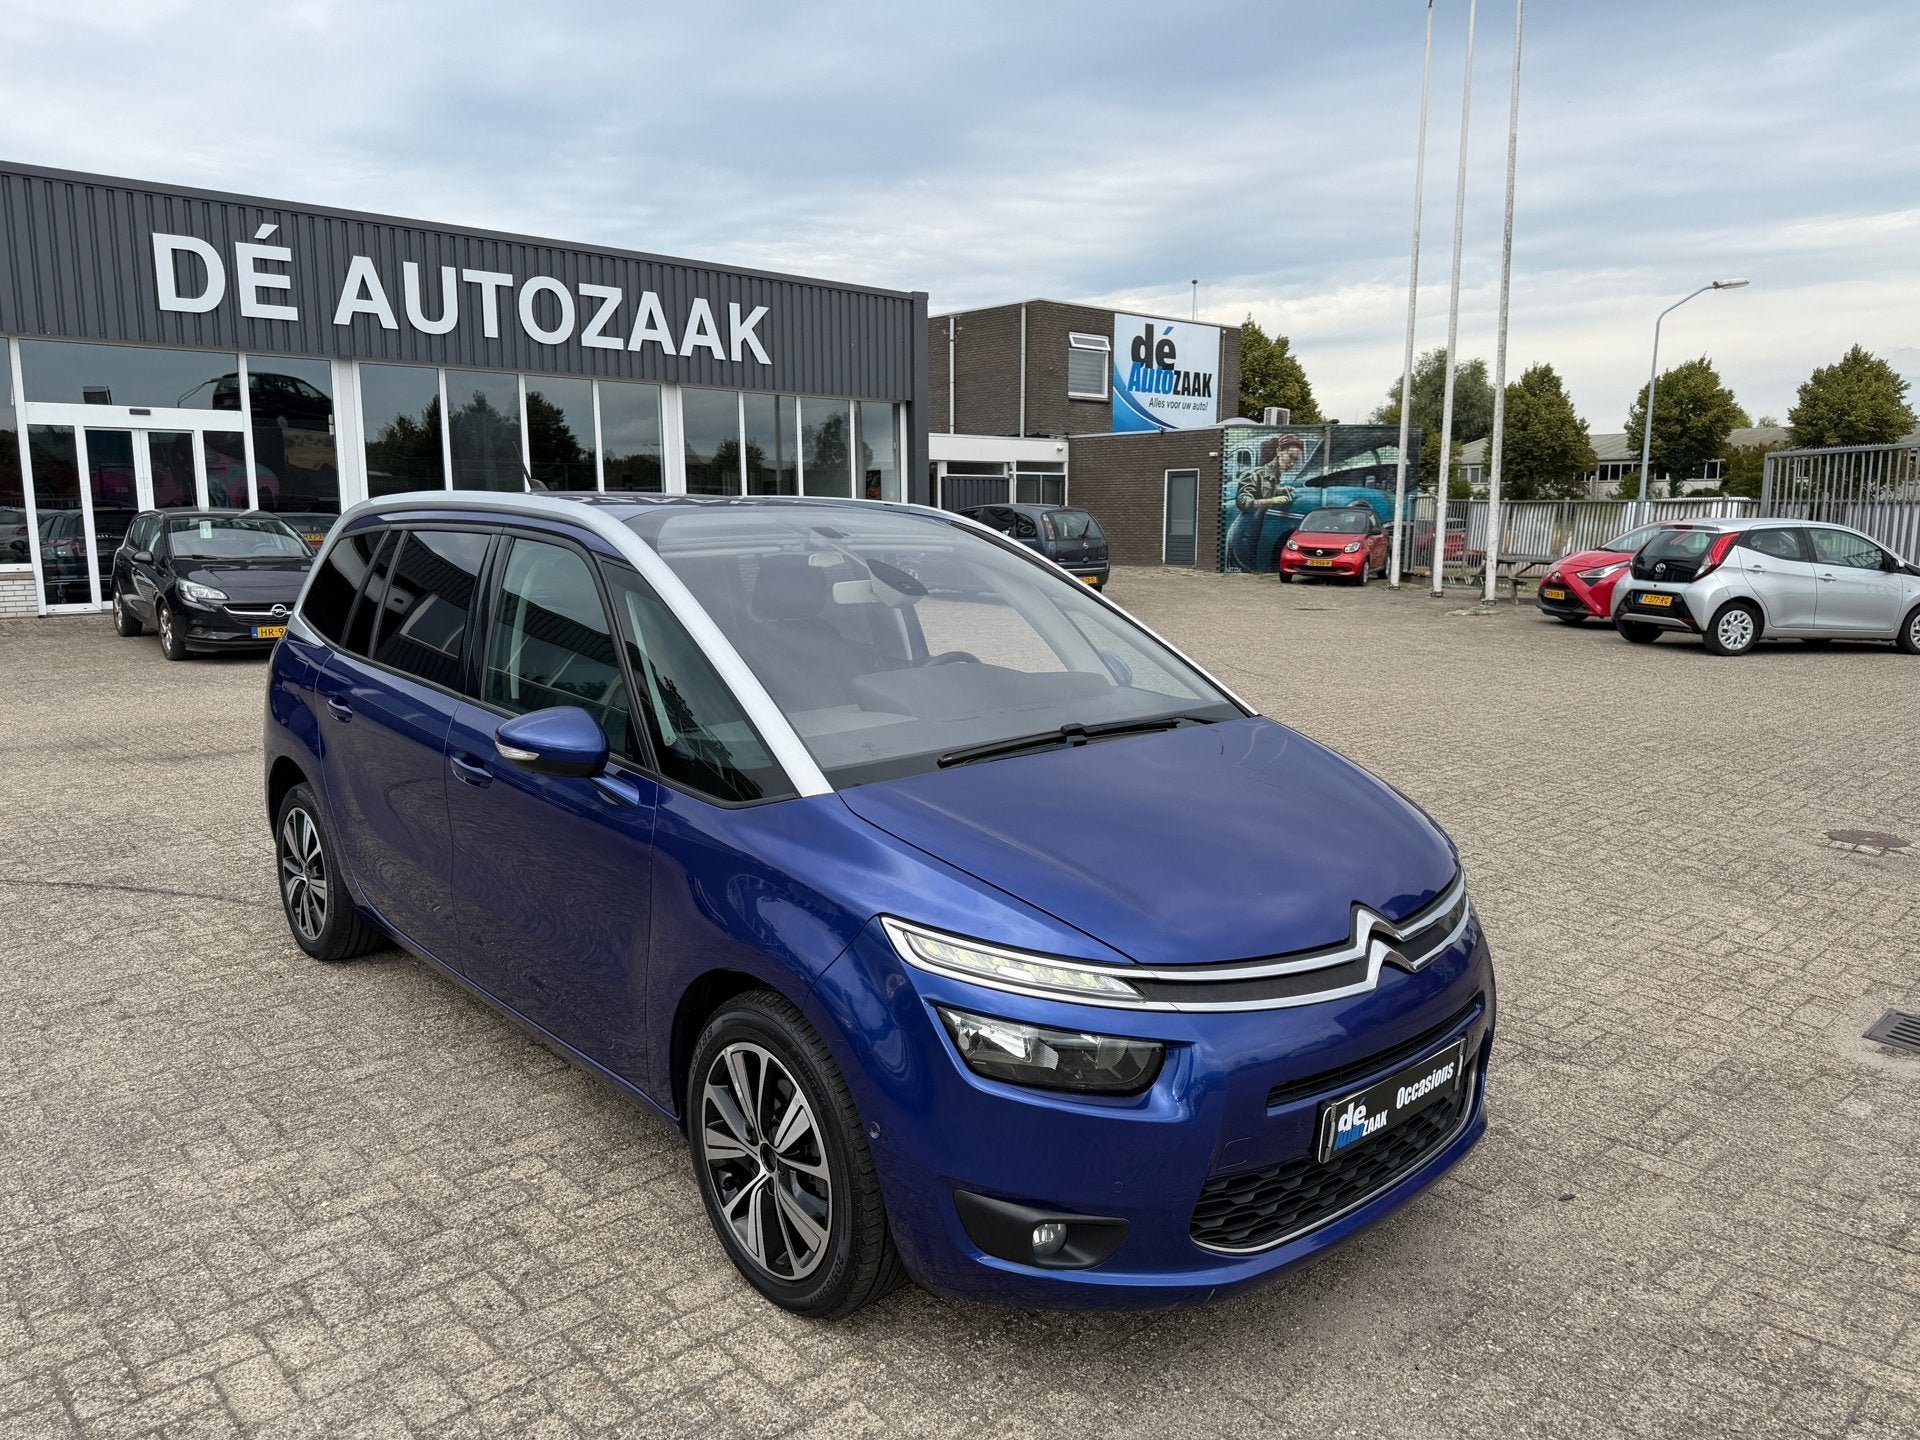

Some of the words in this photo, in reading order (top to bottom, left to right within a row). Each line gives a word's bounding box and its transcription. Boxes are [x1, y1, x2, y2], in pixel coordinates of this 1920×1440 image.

[152, 223, 299, 322] DÉ
[333, 255, 772, 365] AUTOZAAK
[1131, 323, 1176, 370] dé
[1148, 397, 1165, 409] Alles
[1166, 400, 1181, 410] voor
[1181, 402, 1192, 410] uw
[1192, 401, 1209, 411] auto!
[1642, 594, 1671, 606] T-377-RG
[1396, 1061, 1455, 1110] Occasions
[1337, 1096, 1367, 1132] dé
